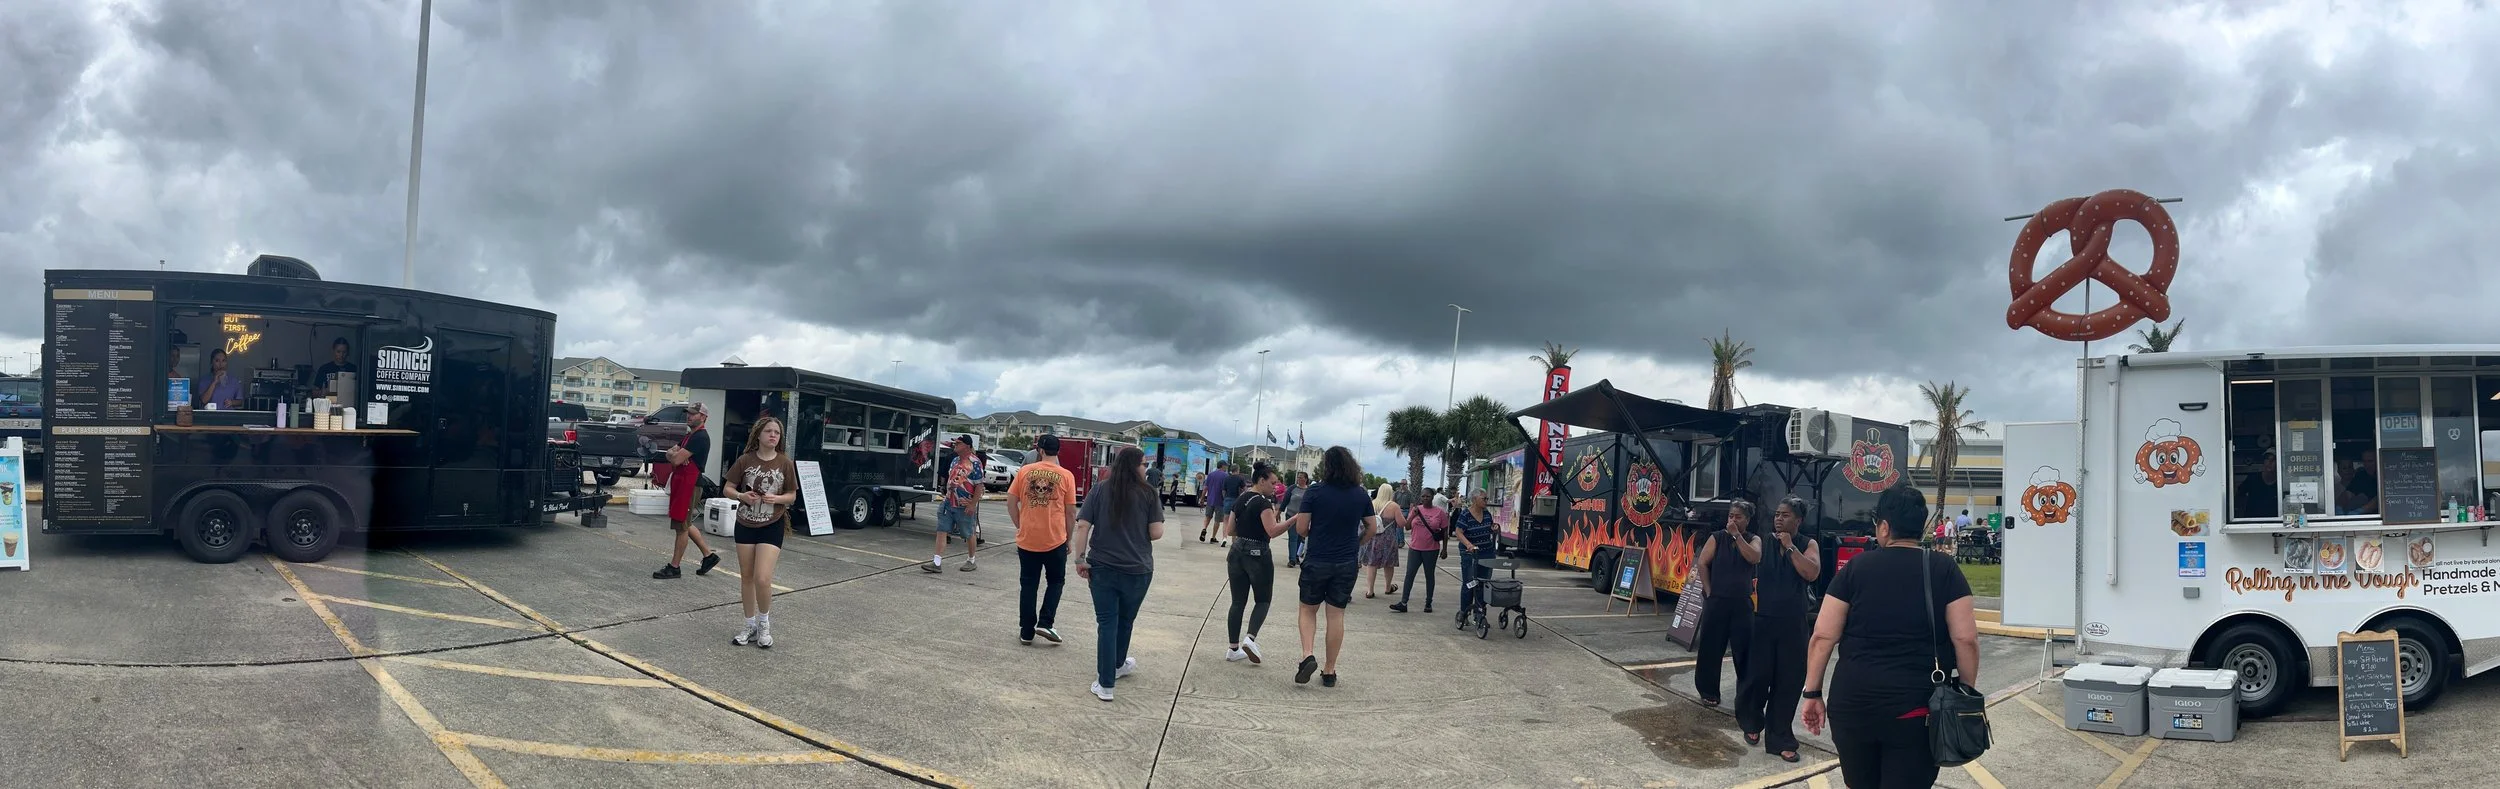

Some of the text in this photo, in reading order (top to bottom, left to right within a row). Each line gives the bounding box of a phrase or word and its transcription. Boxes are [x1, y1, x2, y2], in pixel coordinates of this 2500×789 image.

[88, 290, 118, 298] MENU
[226, 334, 260, 354] Coffee
[378, 350, 431, 371] SIRINCCI
[376, 370, 430, 381] COFFEE COMPANY
[376, 384, 429, 393] WWW.SIRINCCI.COM
[1548, 375, 1567, 467] FUNEL
[2385, 417, 2415, 429] OPEN
[744, 465, 774, 478] Selena
[2423, 566, 2496, 580] Handmade
[2226, 567, 2297, 602] Rolling
[2300, 576, 2319, 590] in
[2354, 565, 2419, 599] Dough
[2424, 581, 2490, 595] Pretzels &
[2088, 693, 2112, 701] IGLOO
